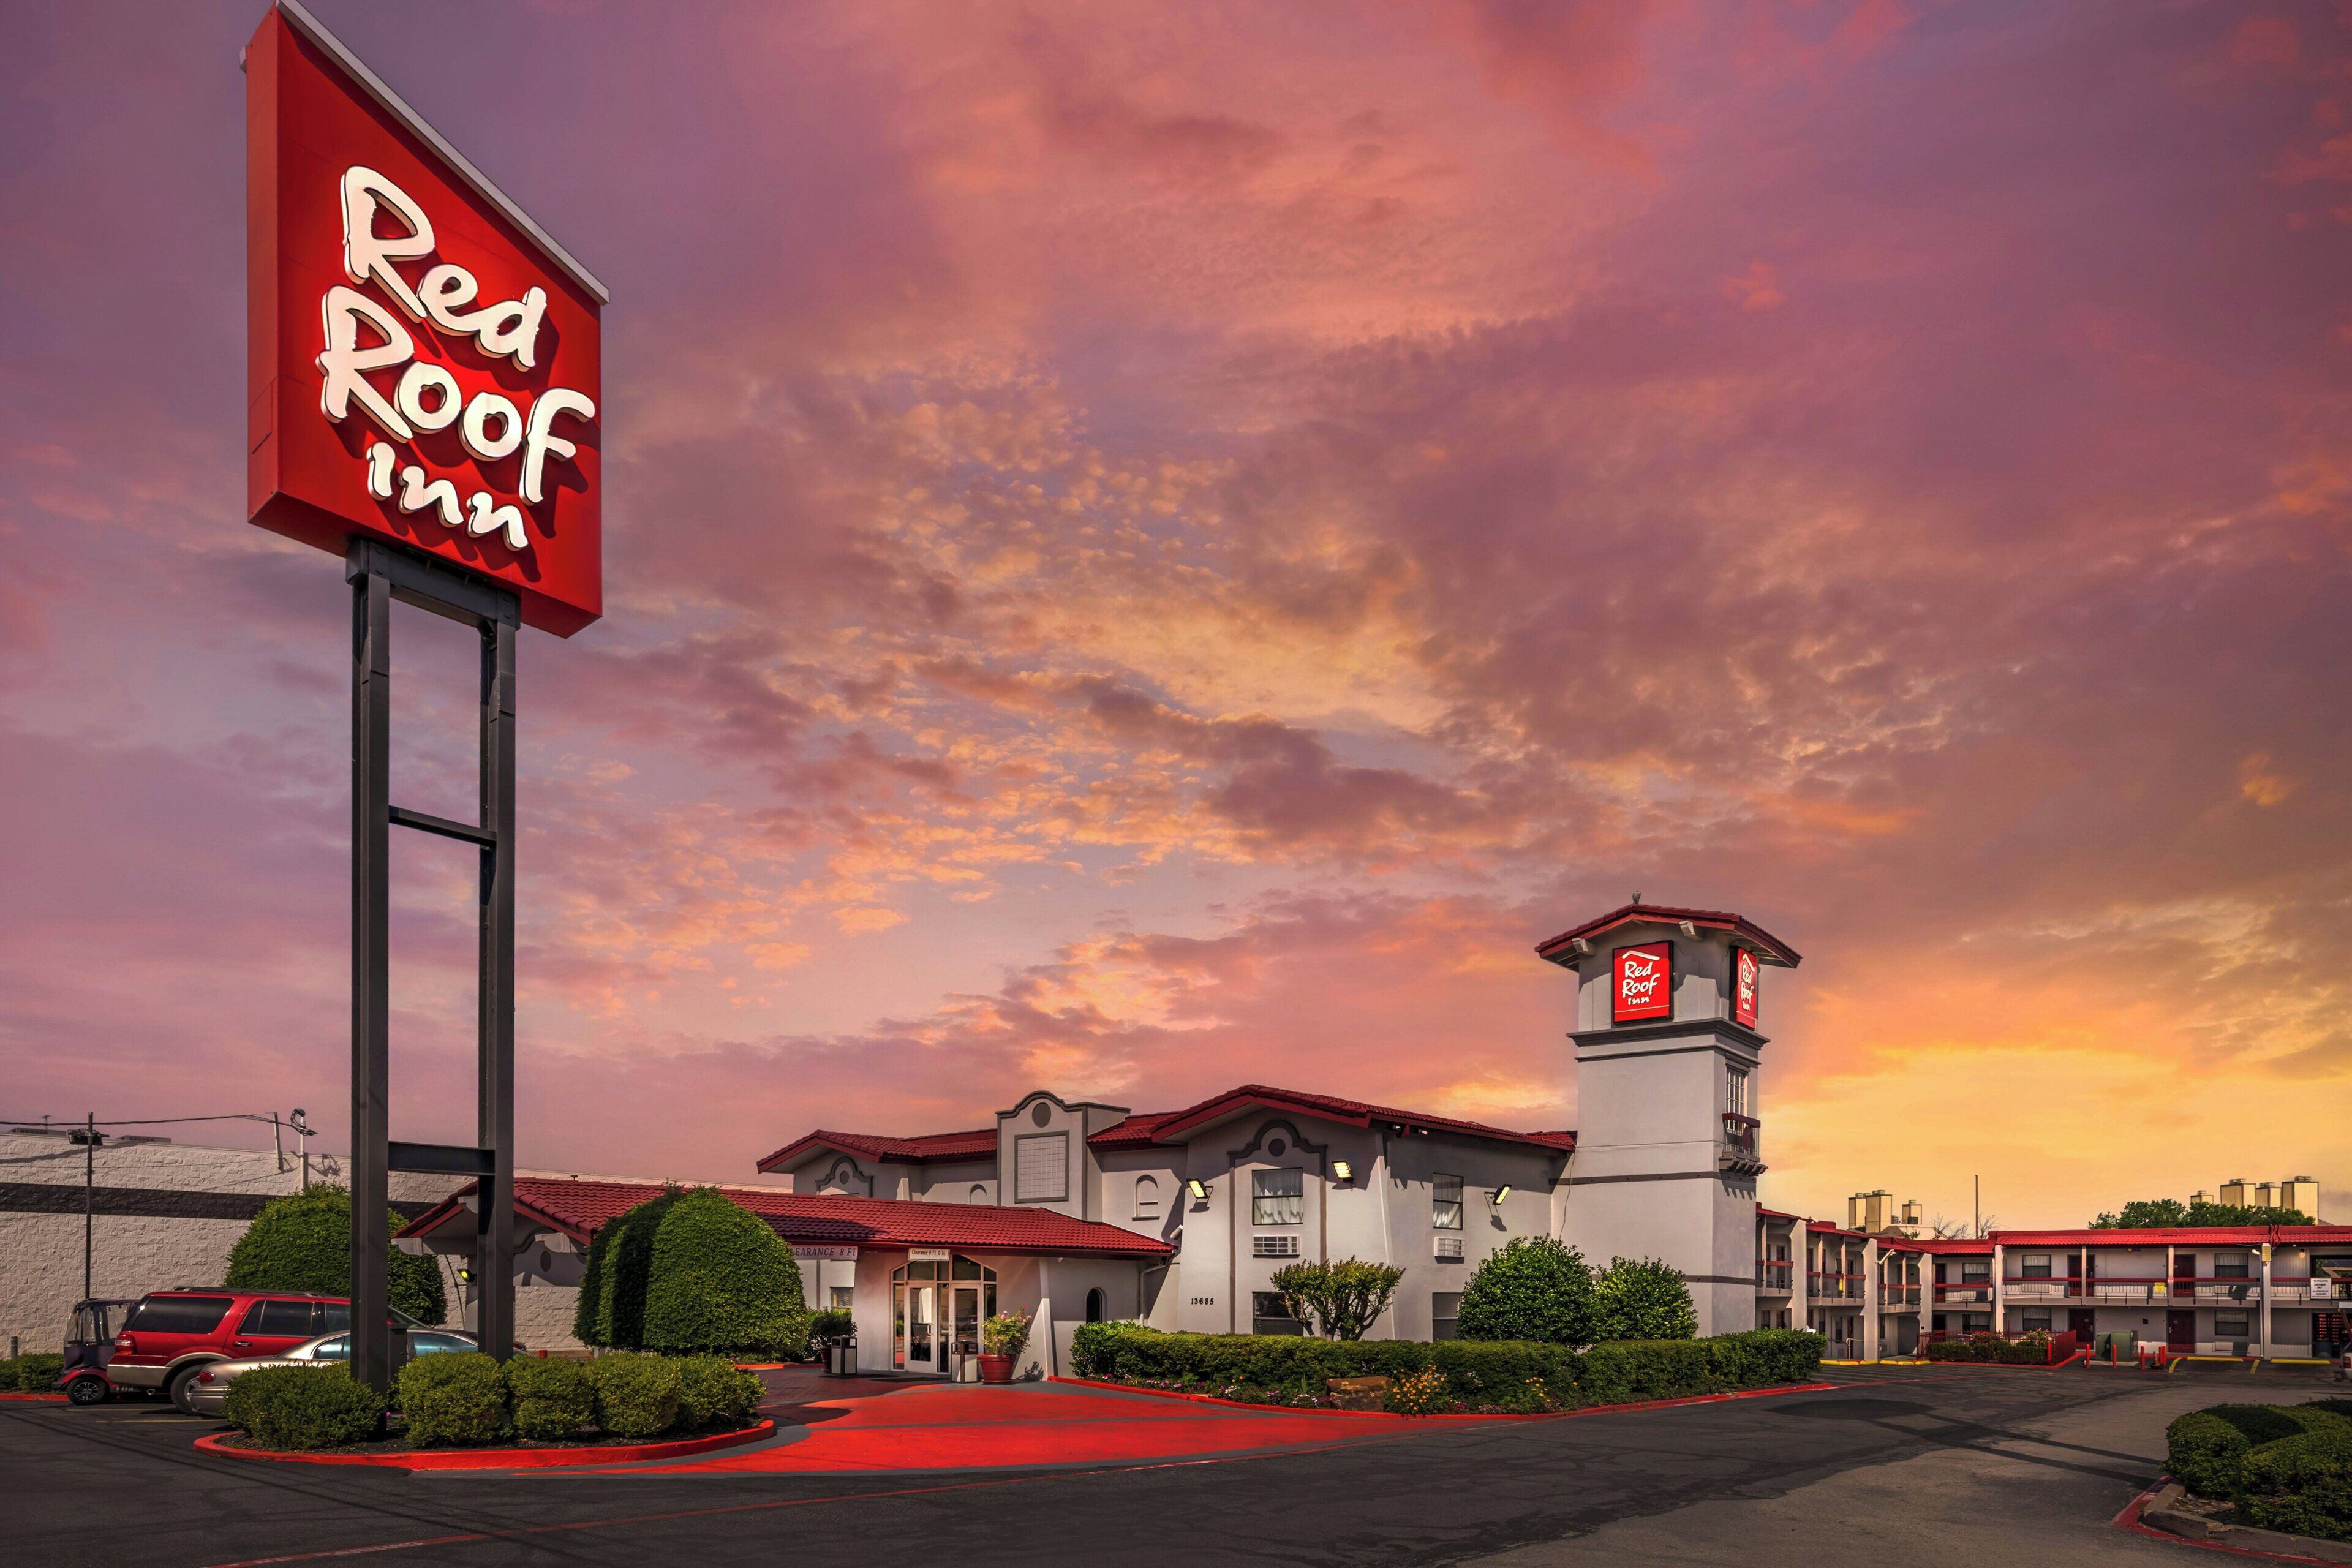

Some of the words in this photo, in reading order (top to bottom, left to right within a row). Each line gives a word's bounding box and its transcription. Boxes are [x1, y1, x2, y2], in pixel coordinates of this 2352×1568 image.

[341, 165, 546, 371] Red
[315, 285, 595, 507] Roof
[1624, 961, 1653, 978] Red
[1742, 963, 1752, 984] Red
[1622, 973, 1660, 998] Roof
[1741, 981, 1754, 1004] Roof
[1628, 996, 1650, 1005] Inn
